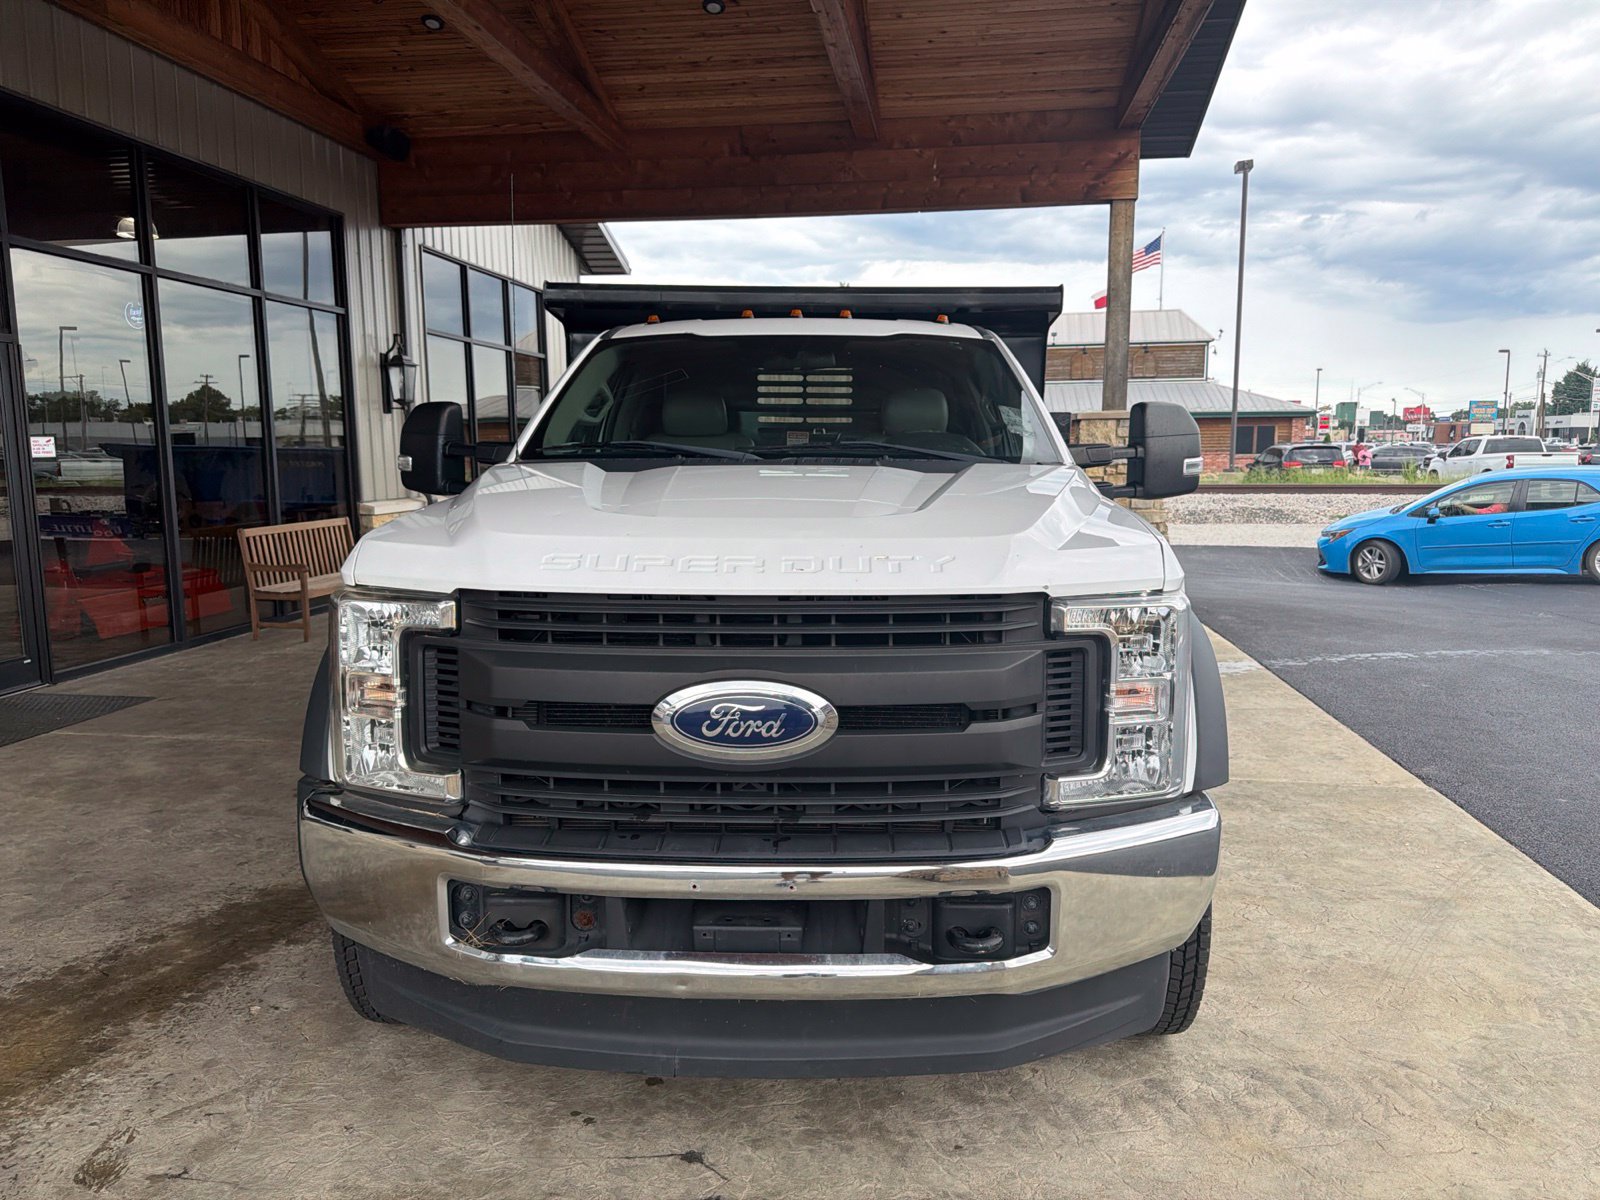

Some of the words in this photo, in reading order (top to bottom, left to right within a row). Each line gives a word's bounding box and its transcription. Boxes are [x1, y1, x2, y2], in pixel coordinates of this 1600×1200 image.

[539, 553, 766, 574] SUPER
[781, 555, 957, 574] DUTY
[701, 702, 787, 738] Ford
